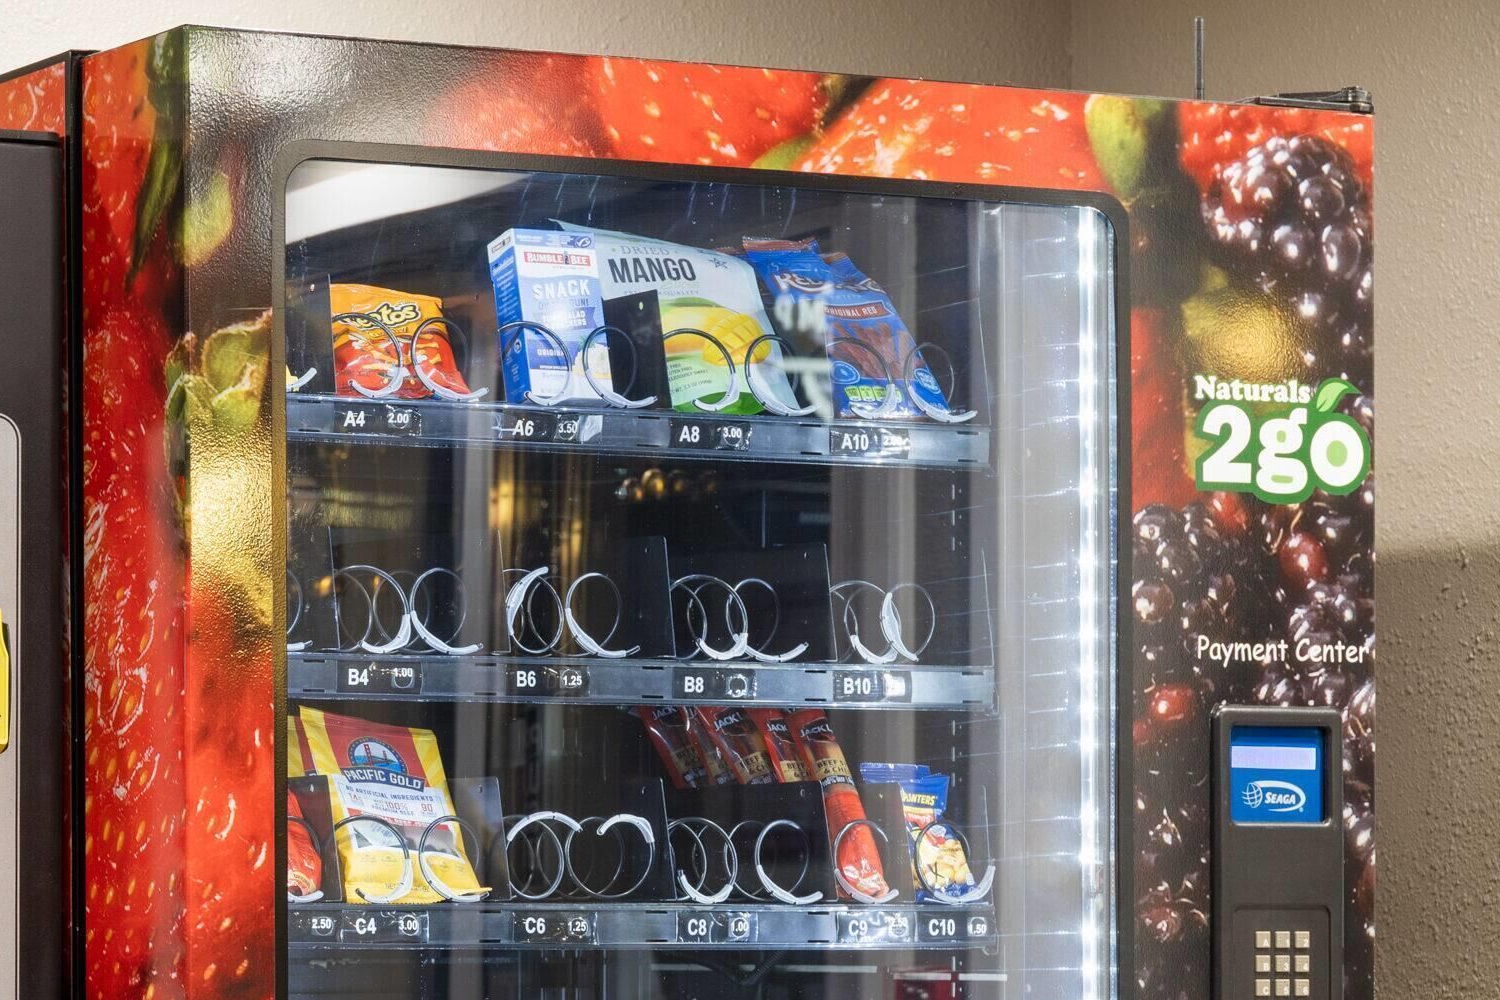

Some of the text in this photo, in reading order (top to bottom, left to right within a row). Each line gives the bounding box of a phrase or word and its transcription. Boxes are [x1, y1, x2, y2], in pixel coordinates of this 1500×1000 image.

[608, 256, 697, 284] MANGO
[532, 279, 591, 300] SNACK
[1193, 374, 1311, 403] Naturals
[343, 411, 410, 428] A4 2.00
[512, 419, 577, 437] A6 3.50
[679, 426, 743, 443] A8 3.00
[841, 433, 869, 450] A10
[1200, 402, 1366, 497] 2go
[1197, 634, 1371, 668] Payment Center
[348, 667, 413, 685] B4 1.00
[516, 670, 582, 687] B6 1.25
[684, 676, 704, 693] B8
[843, 677, 871, 694] B10
[343, 768, 421, 789] PACIFIC GOLD
[1264, 791, 1296, 805] SEAGA
[311, 918, 332, 929] 2.50
[355, 917, 418, 934] C4 3.00
[525, 917, 587, 934] C6 1.25
[687, 919, 748, 936] C8 1.00
[848, 919, 868, 936] C9
[928, 919, 955, 936] C10
